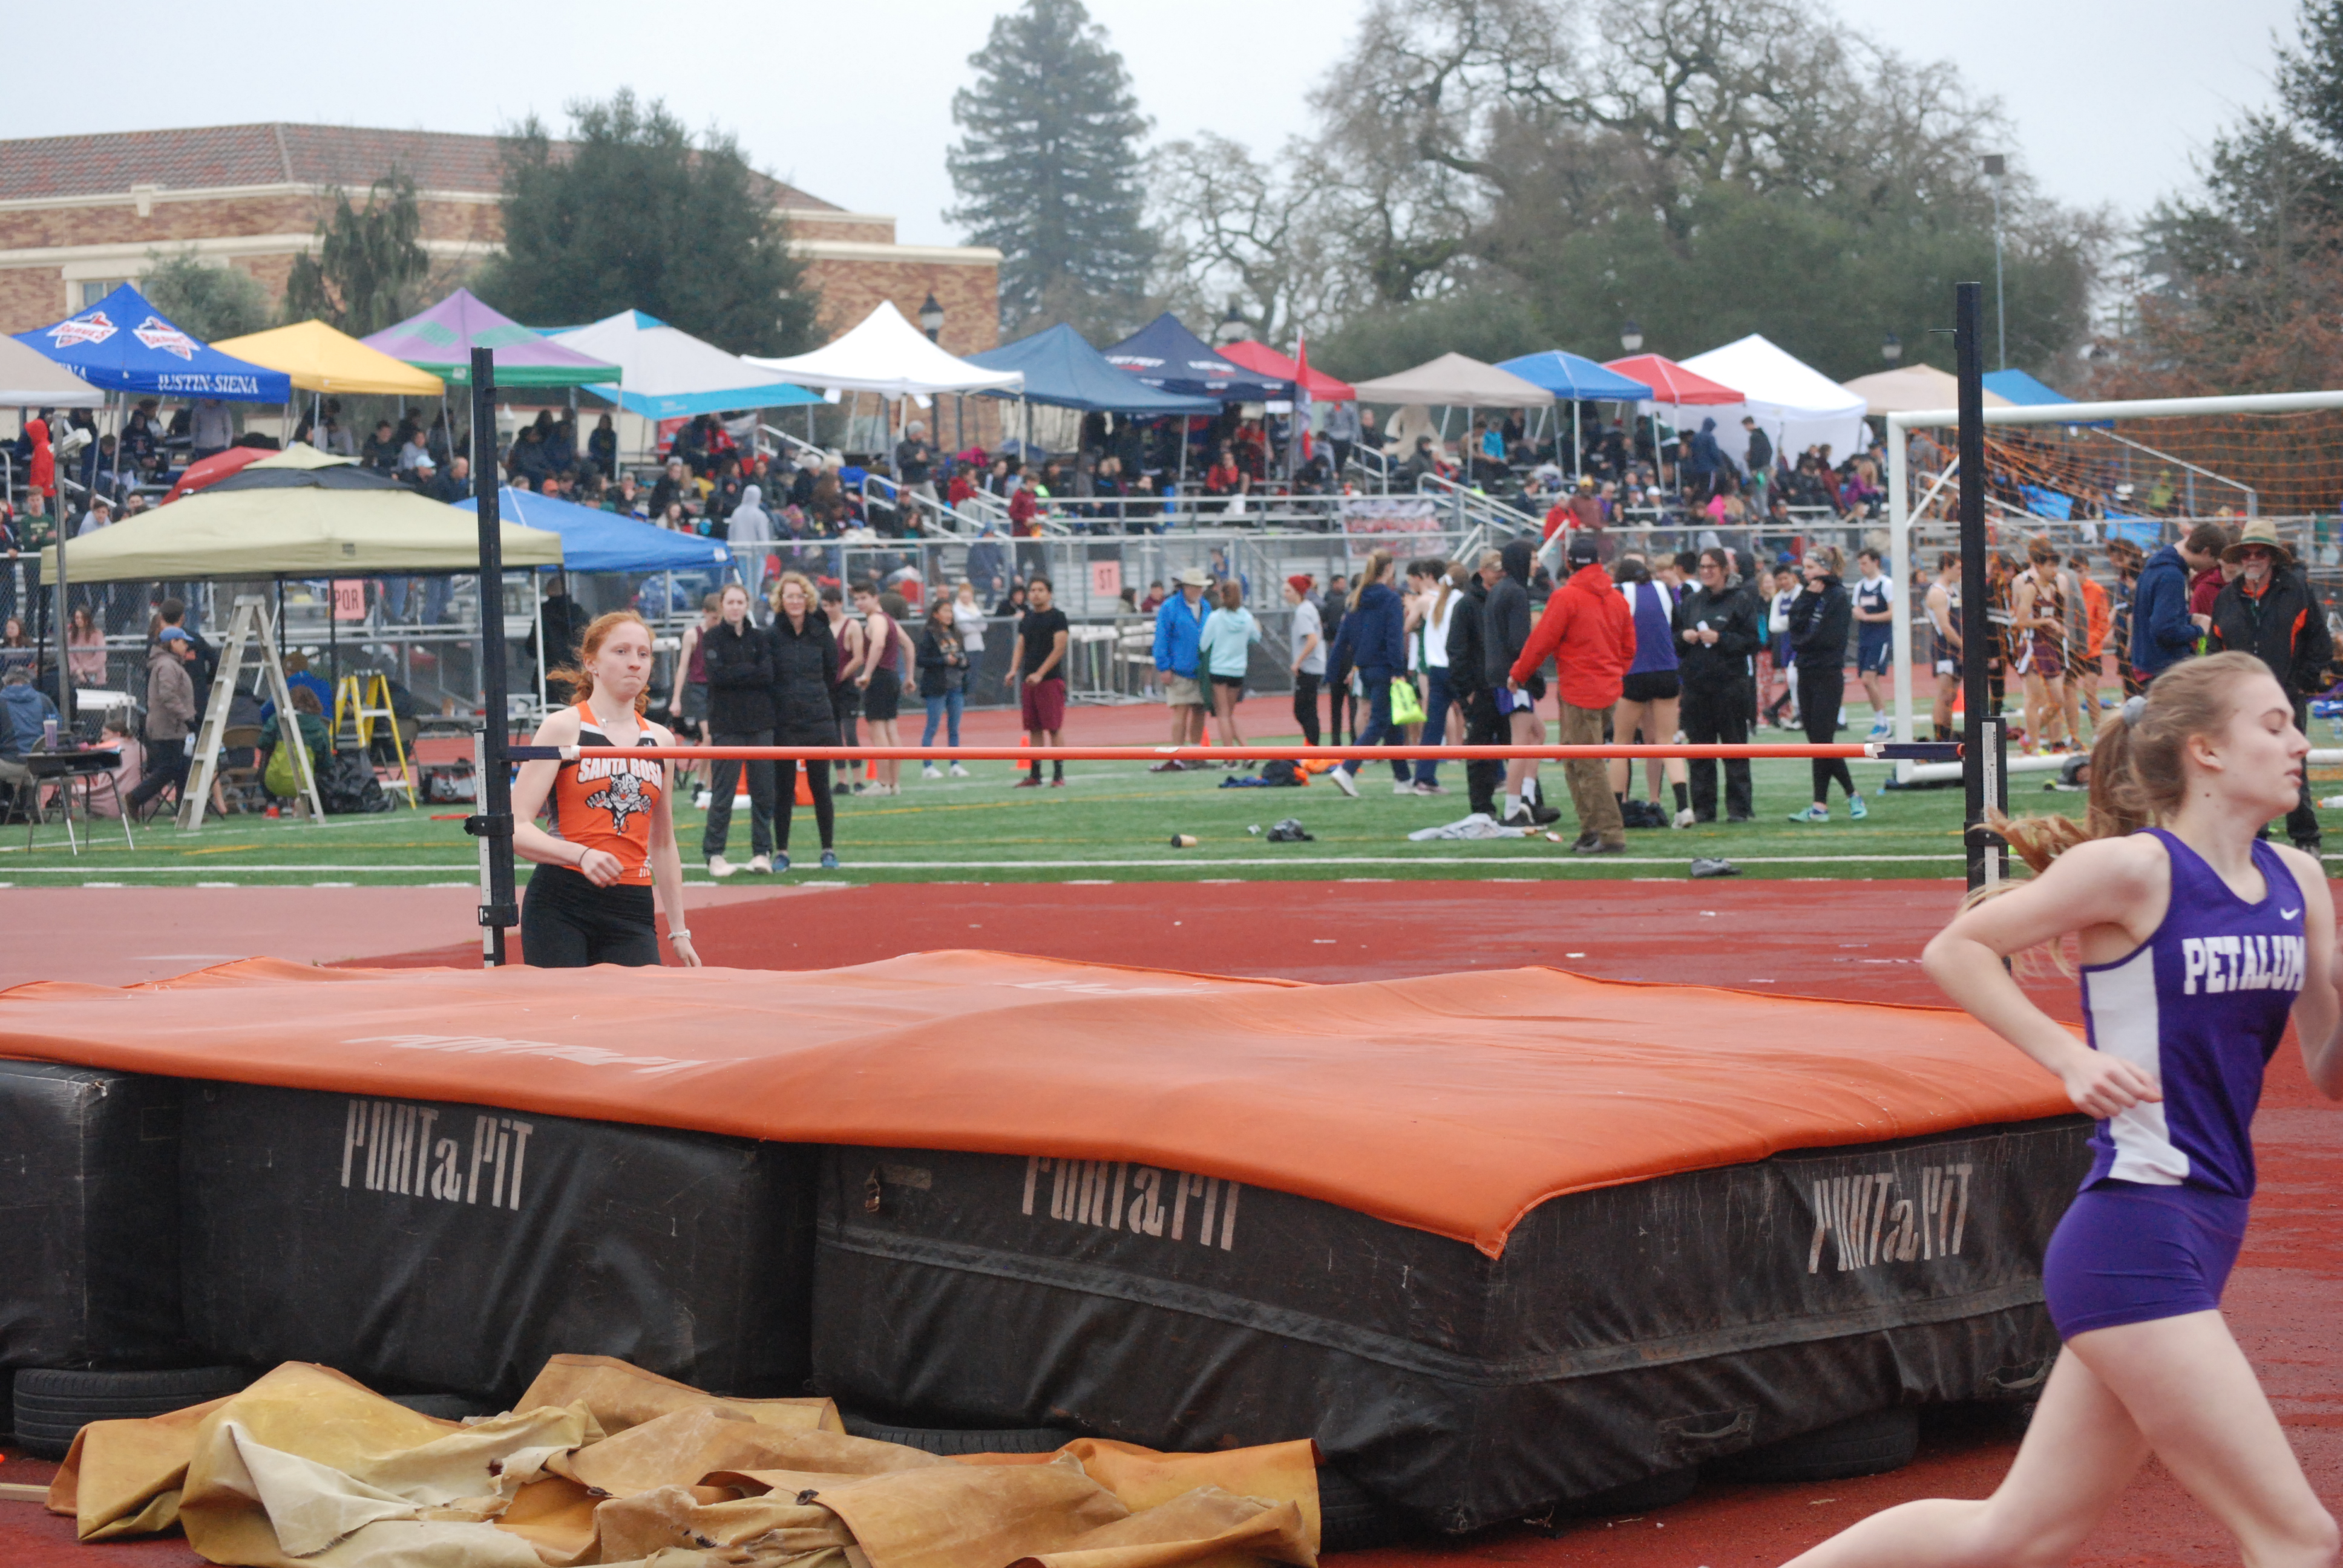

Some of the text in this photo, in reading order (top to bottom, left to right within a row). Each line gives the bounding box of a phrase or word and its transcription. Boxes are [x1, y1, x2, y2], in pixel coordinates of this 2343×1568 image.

[1098, 568, 1113, 590] ST
[335, 588, 359, 610] PQR
[578, 757, 628, 783] SANTA
[341, 1099, 439, 1197] PORT
